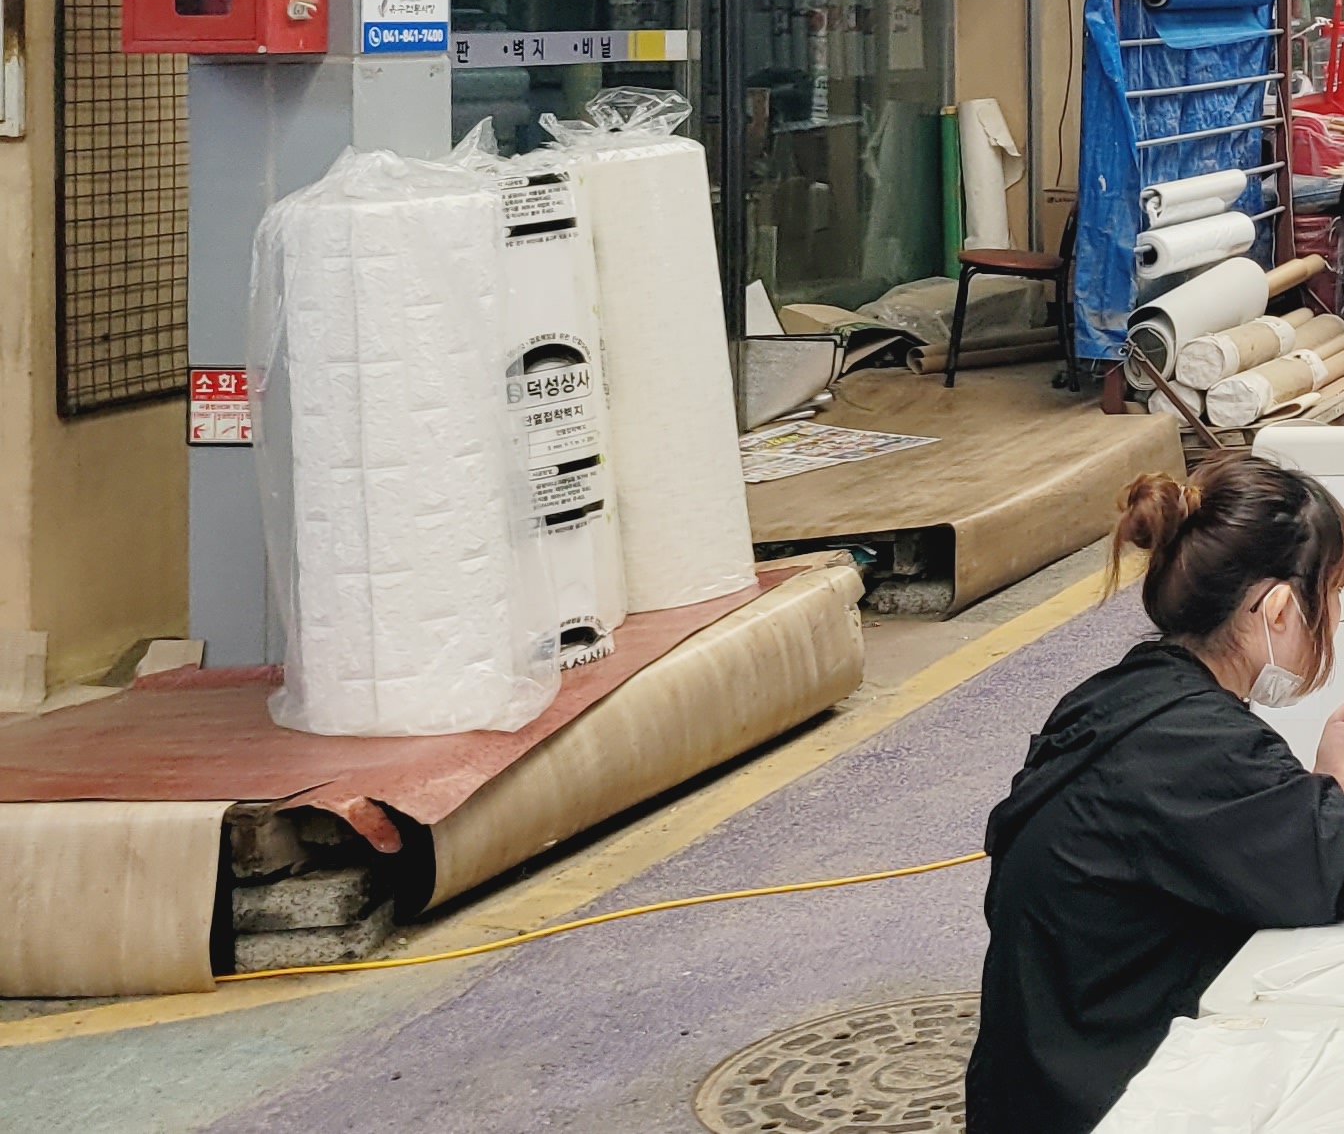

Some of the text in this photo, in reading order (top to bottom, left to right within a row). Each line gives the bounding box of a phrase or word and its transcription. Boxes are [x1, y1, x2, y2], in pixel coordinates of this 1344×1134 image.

[382, 29, 444, 44] 041-841-7400
[512, 37, 545, 62] 벽지
[581, 36, 612, 60] 비닐
[526, 369, 590, 400] 덕성상사
